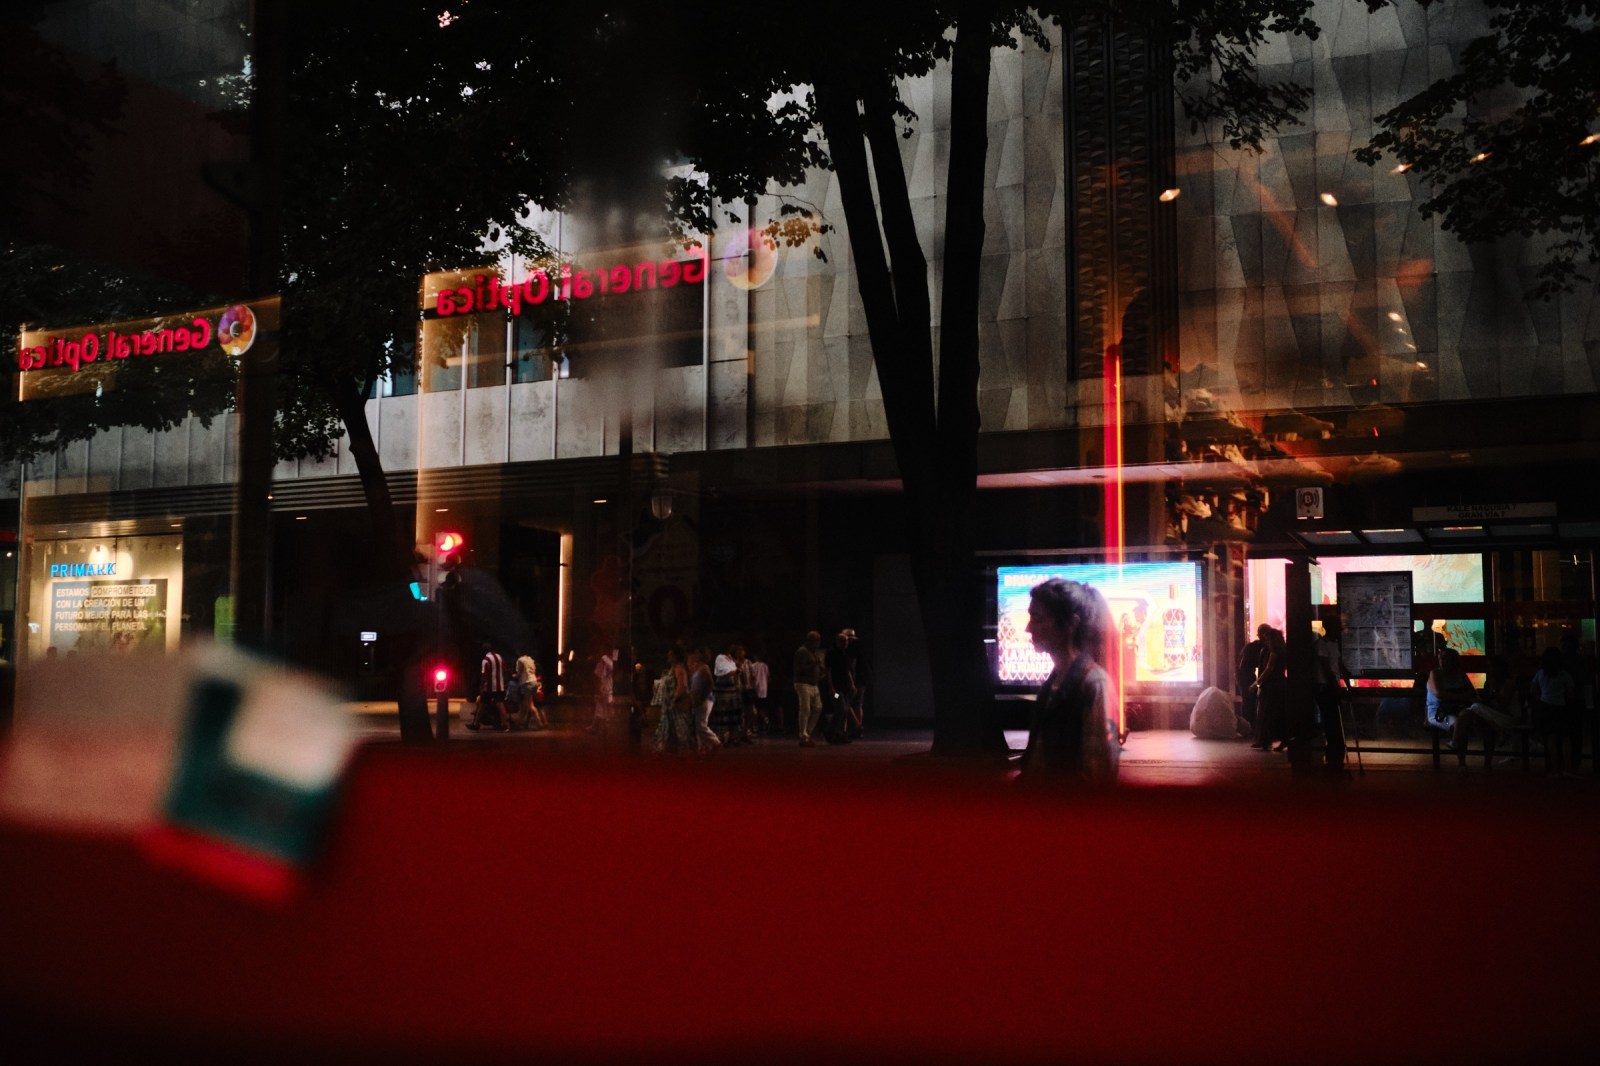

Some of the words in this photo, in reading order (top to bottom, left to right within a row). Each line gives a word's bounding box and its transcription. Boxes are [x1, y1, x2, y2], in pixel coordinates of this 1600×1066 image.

[51, 563, 116, 577] PRIMARK
[56, 588, 89, 597] ESTAMOS
[93, 586, 155, 596] COMPROMETIDOS
[55, 599, 71, 608] CON
[73, 599, 82, 608] LA
[84, 597, 121, 608] CREACIÓN
[122, 598, 133, 607] DE
[134, 598, 145, 607] UN
[55, 610, 84, 620] FUTURO
[85, 610, 110, 620] MEJOR
[111, 609, 132, 619] PARA
[133, 609, 148, 619] LAS
[54, 622, 92, 632] PERSONAS
